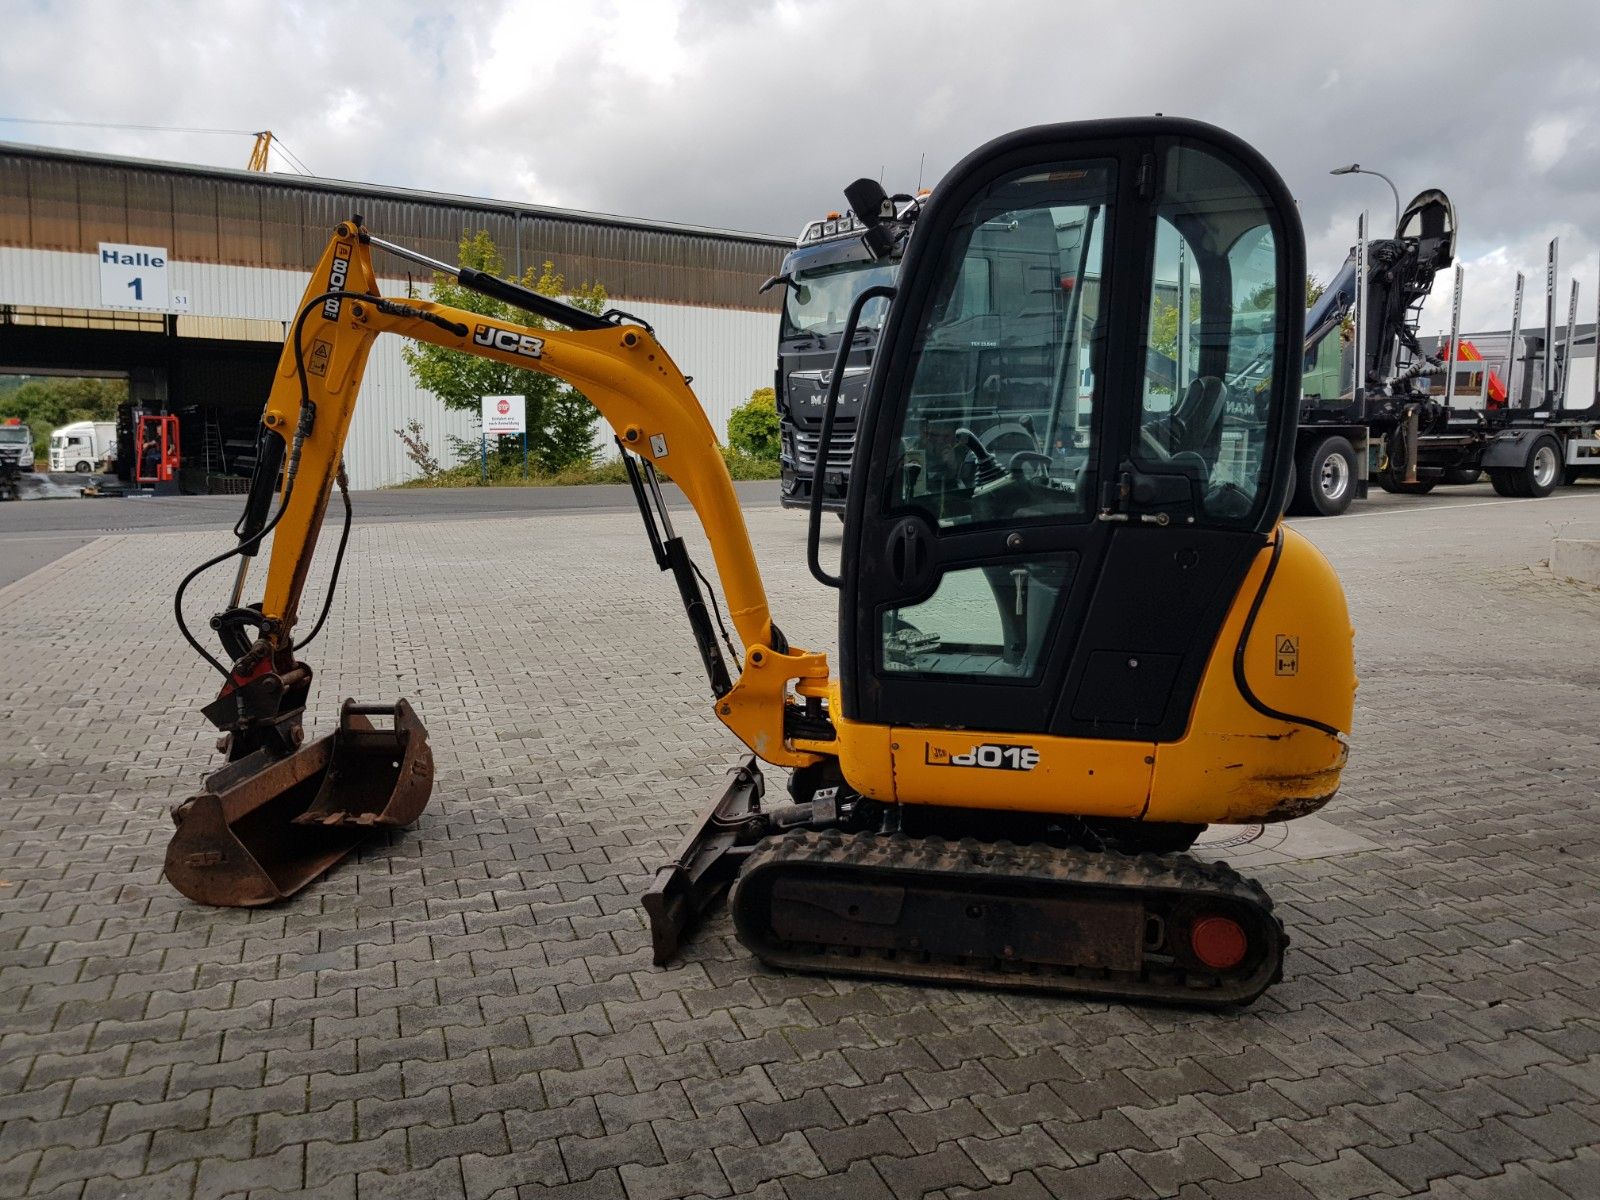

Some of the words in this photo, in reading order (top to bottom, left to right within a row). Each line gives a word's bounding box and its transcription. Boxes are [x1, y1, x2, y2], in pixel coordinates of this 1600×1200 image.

[102, 249, 165, 268] Halle
[128, 277, 143, 301] 1
[475, 327, 544, 357] JCB
